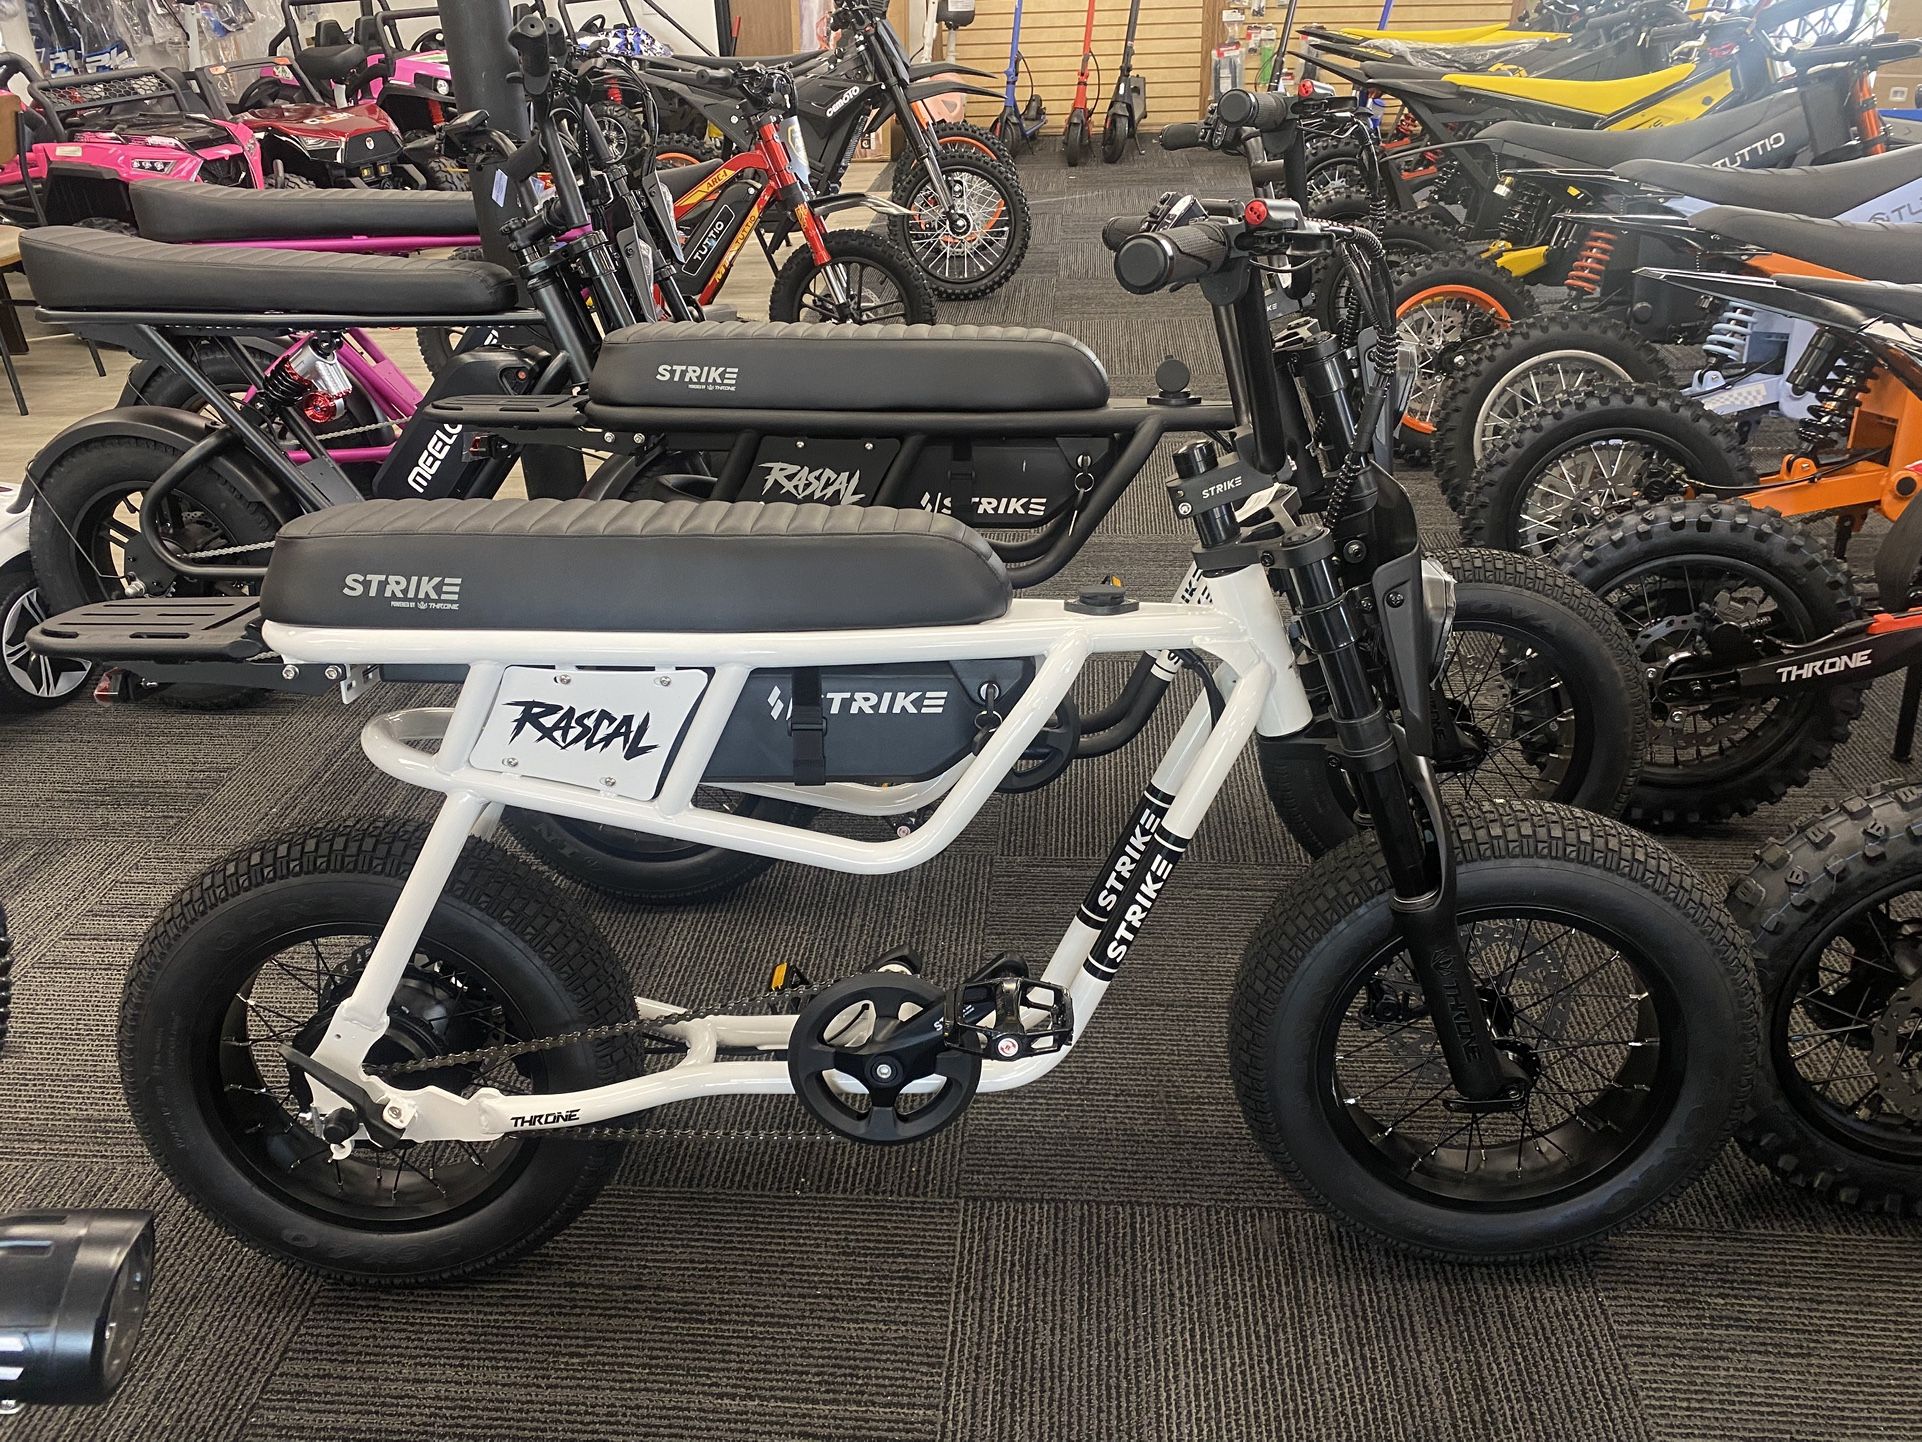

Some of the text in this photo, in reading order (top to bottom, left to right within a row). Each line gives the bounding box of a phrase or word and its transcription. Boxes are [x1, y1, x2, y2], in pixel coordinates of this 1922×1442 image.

[693, 220, 725, 261] TUTTIO
[735, 215, 756, 245] TUTTIO
[655, 364, 739, 384] STRIKE
[758, 462, 866, 506] RASCAL
[1202, 475, 1242, 499] STRIKE
[342, 573, 462, 601] STRIKE
[428, 602, 460, 610] THRONE
[1776, 649, 1873, 683] THRONE
[822, 691, 948, 714] TRIKE
[501, 699, 660, 760] RASCAL
[1098, 808, 1161, 911] STRIKE
[1107, 853, 1173, 963] STRIKE
[510, 1108, 581, 1127] THRONE
